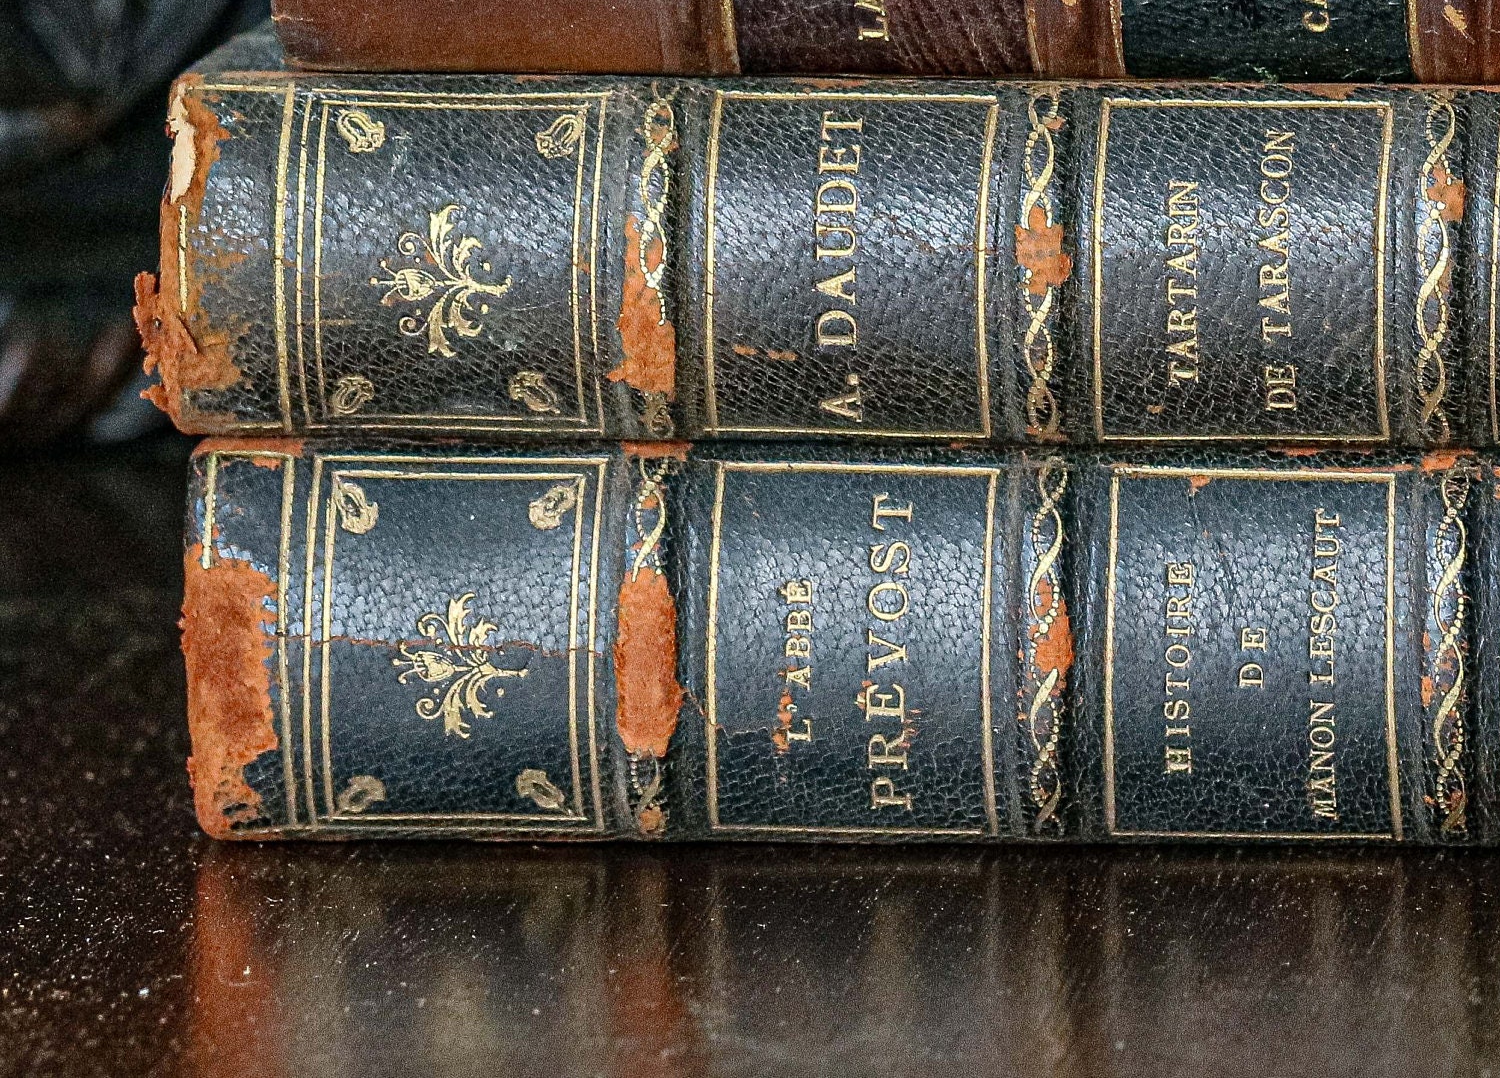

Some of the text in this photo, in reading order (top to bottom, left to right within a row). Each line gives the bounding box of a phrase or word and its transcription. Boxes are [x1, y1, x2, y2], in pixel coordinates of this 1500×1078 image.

[814, 110, 864, 423] A. DAUDET
[1166, 179, 1199, 387] TARTARIN
[1258, 129, 1299, 412] DE TARASCON
[855, 492, 914, 812] PRÉVOST
[1164, 561, 1194, 775] HISTOIRE
[1239, 627, 1267, 689] DE
[1309, 508, 1341, 821] MANON LESCAUT
